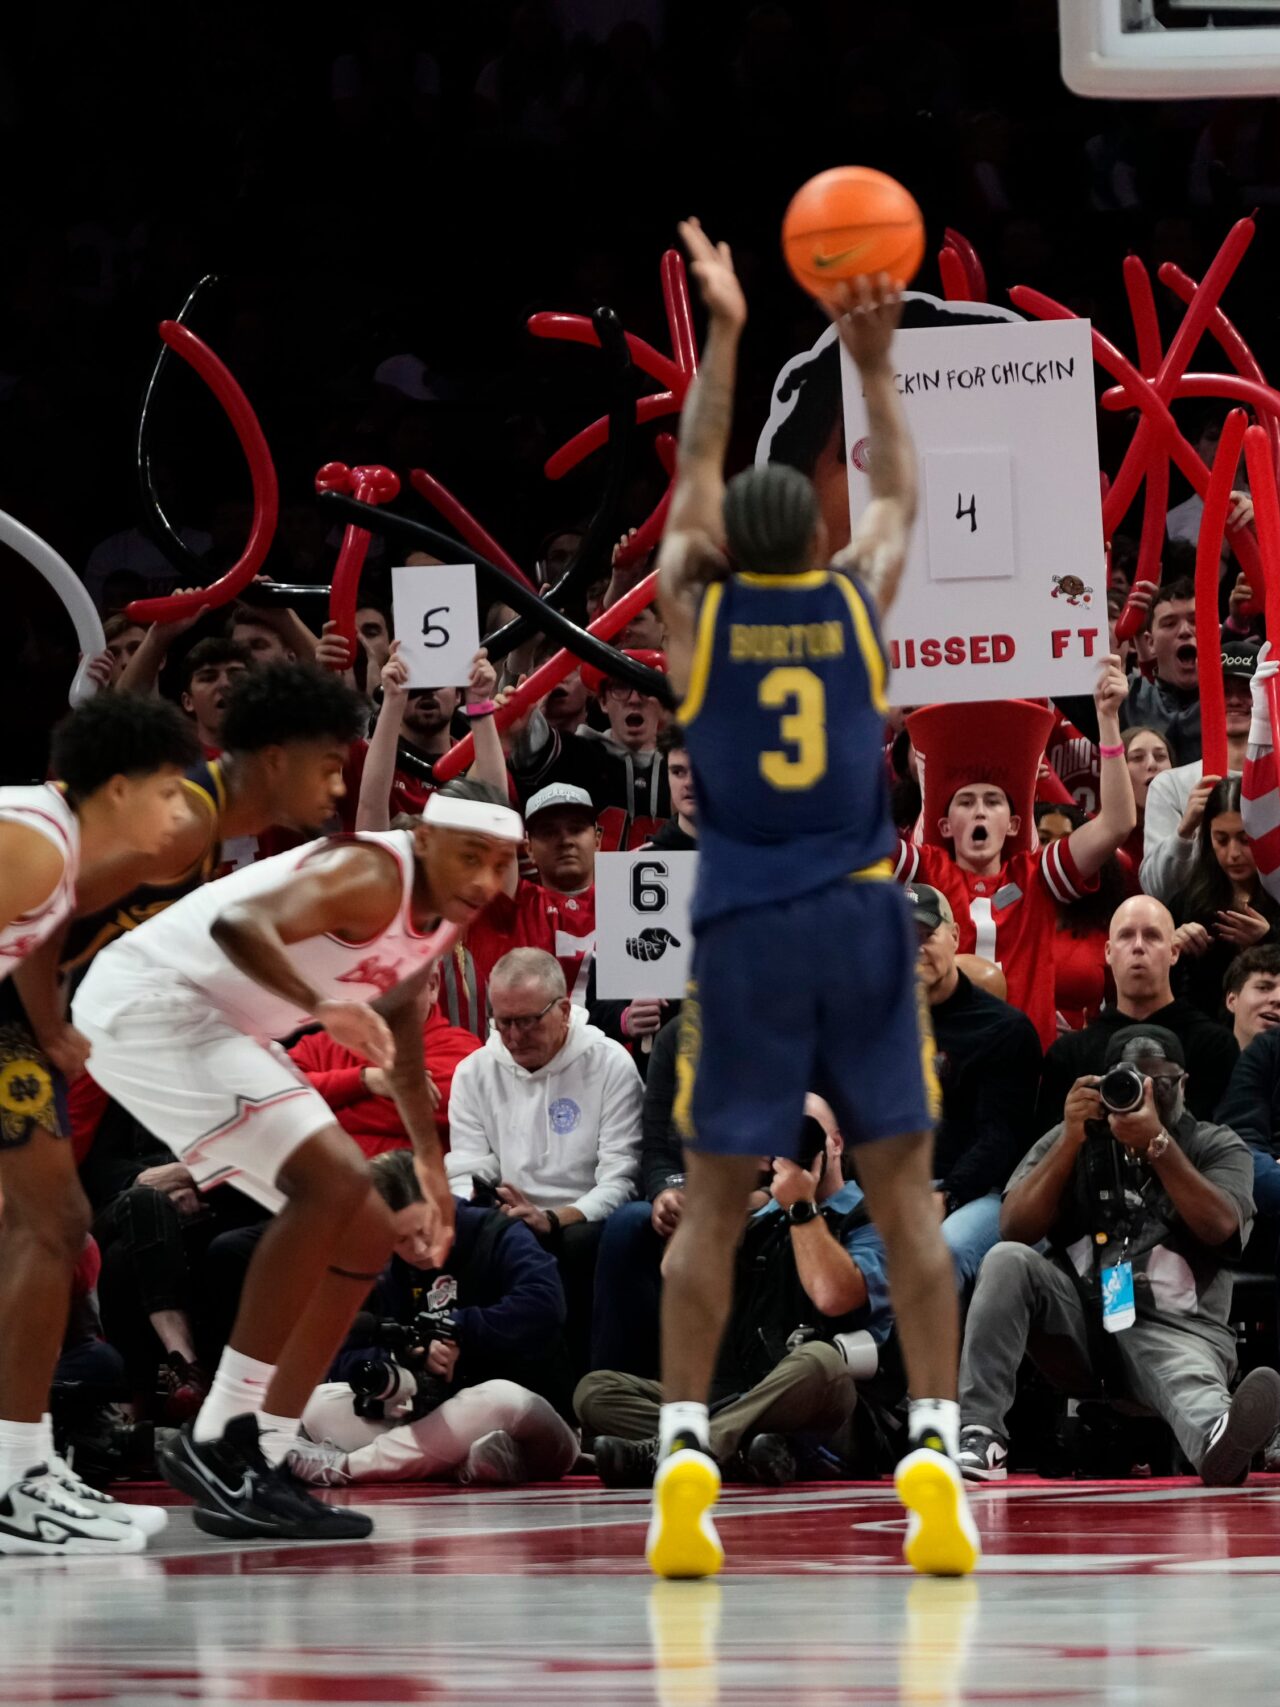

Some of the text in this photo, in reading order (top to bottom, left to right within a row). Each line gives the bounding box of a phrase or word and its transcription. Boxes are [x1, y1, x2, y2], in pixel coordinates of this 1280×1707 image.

[893, 357, 1074, 395] CKIN FOR CHICKIN
[955, 492, 977, 533] 4
[421, 606, 450, 648] 5
[730, 621, 844, 660] BURTON
[1051, 628, 1098, 658] FT
[758, 665, 827, 791] 3
[630, 860, 668, 914] 6
